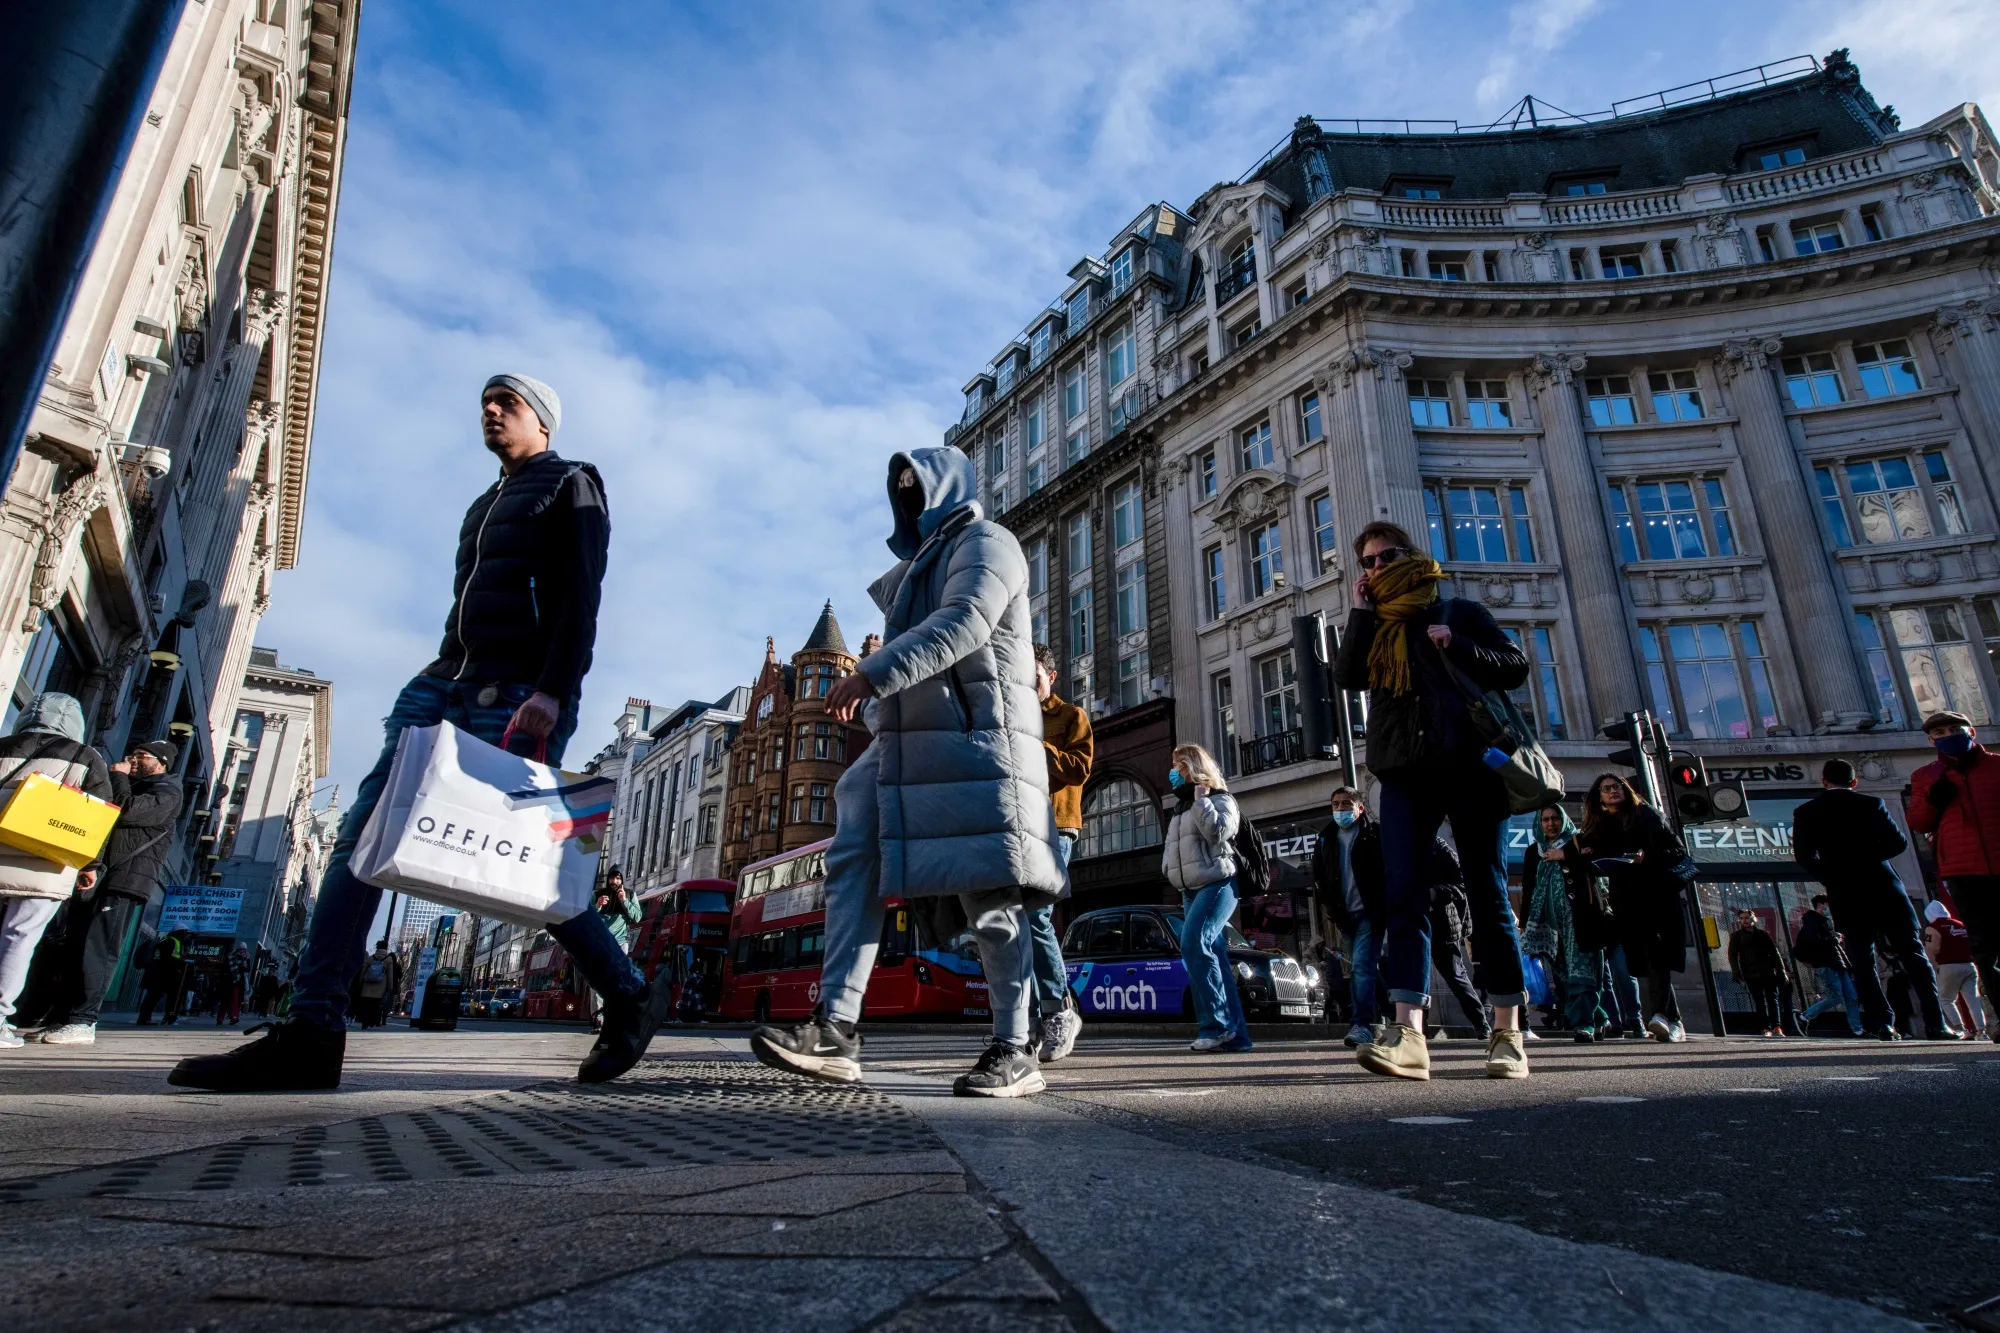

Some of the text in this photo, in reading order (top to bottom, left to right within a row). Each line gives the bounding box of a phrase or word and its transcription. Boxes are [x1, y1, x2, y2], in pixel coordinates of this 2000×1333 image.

[48, 818, 87, 837] SELFRIDGES
[417, 816, 531, 863] OFFICE
[412, 833, 477, 858] www.office.co.uk
[1263, 833, 1320, 859] TEZE
[169, 887, 243, 899] JESUS CHRIST
[698, 927, 723, 937] Victoria
[1092, 974, 1157, 1011] cinch
